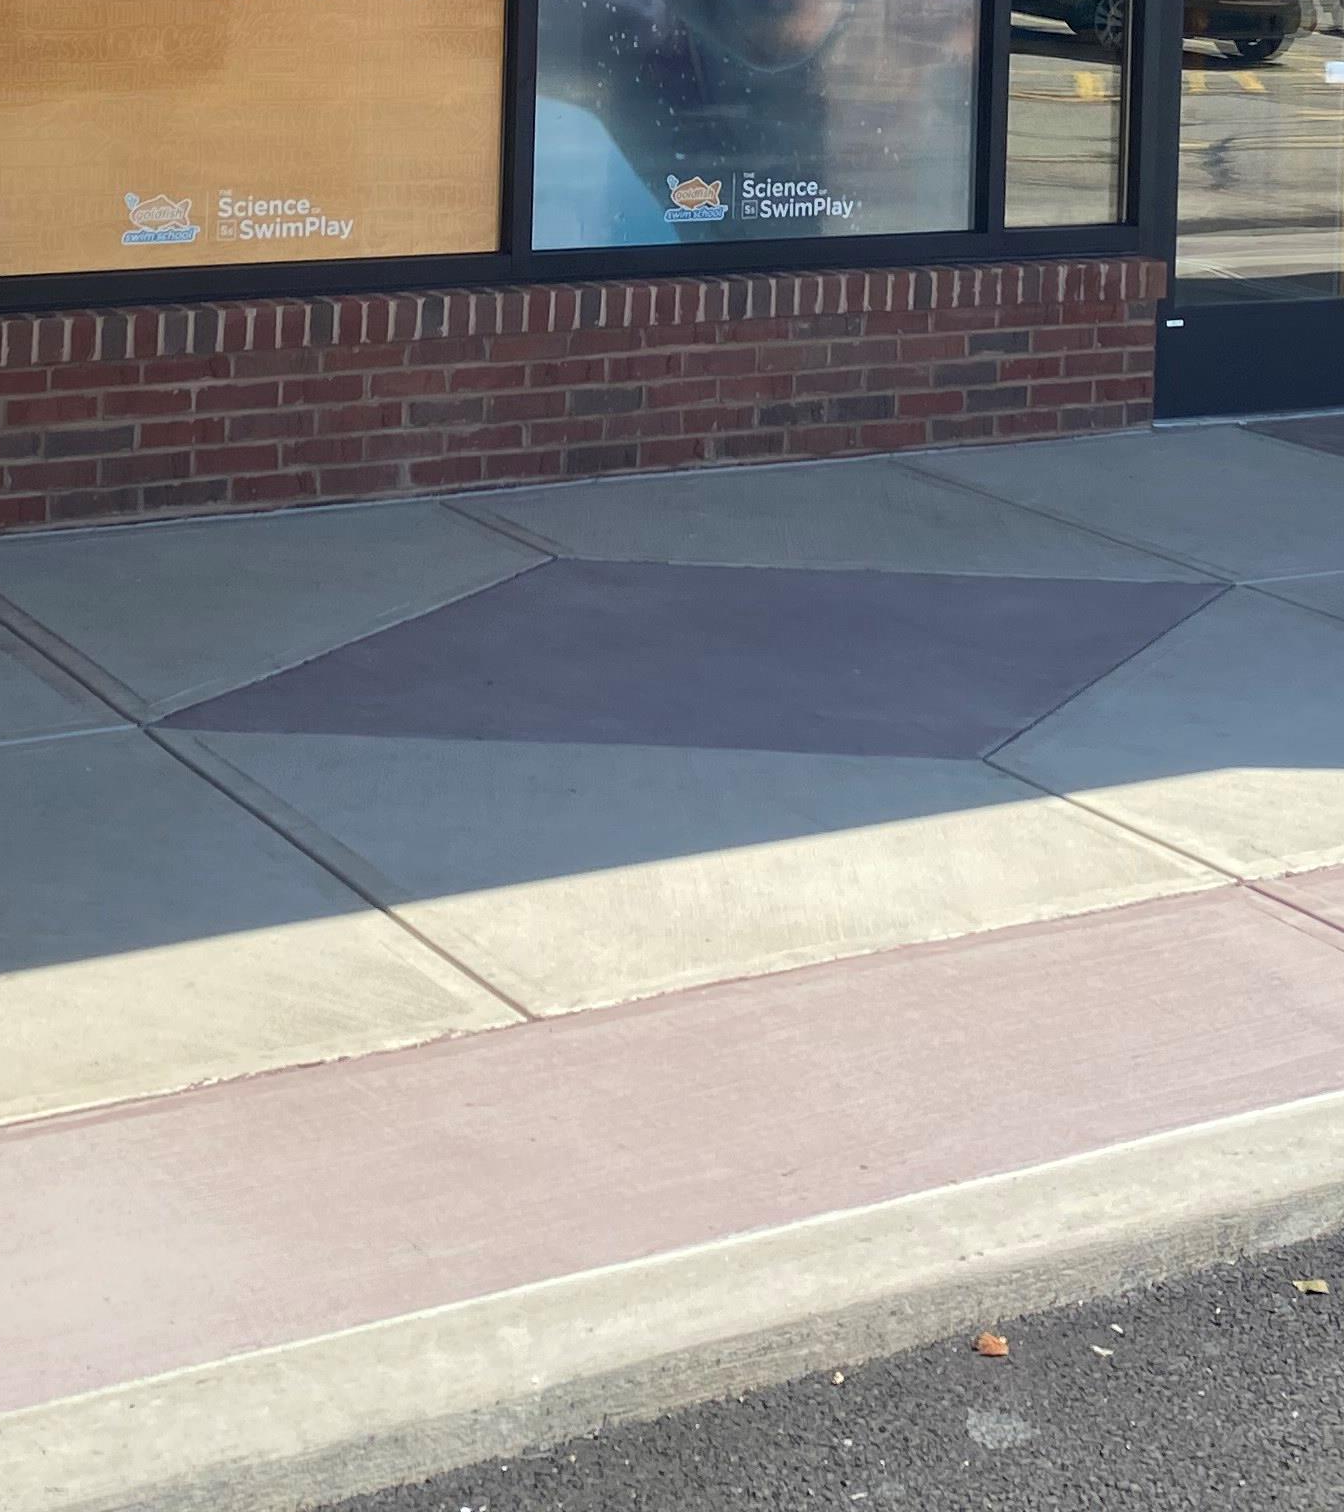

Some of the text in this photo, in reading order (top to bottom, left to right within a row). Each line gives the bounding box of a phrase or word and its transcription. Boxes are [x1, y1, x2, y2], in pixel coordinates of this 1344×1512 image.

[675, 187, 714, 201] goldfish
[742, 177, 819, 199] Science
[134, 204, 186, 223] goldfish
[218, 195, 310, 218] Science
[665, 208, 724, 219] swim school
[760, 197, 854, 219] SwimPlay
[124, 227, 194, 242] swim school
[239, 215, 354, 240] SwimPlay
